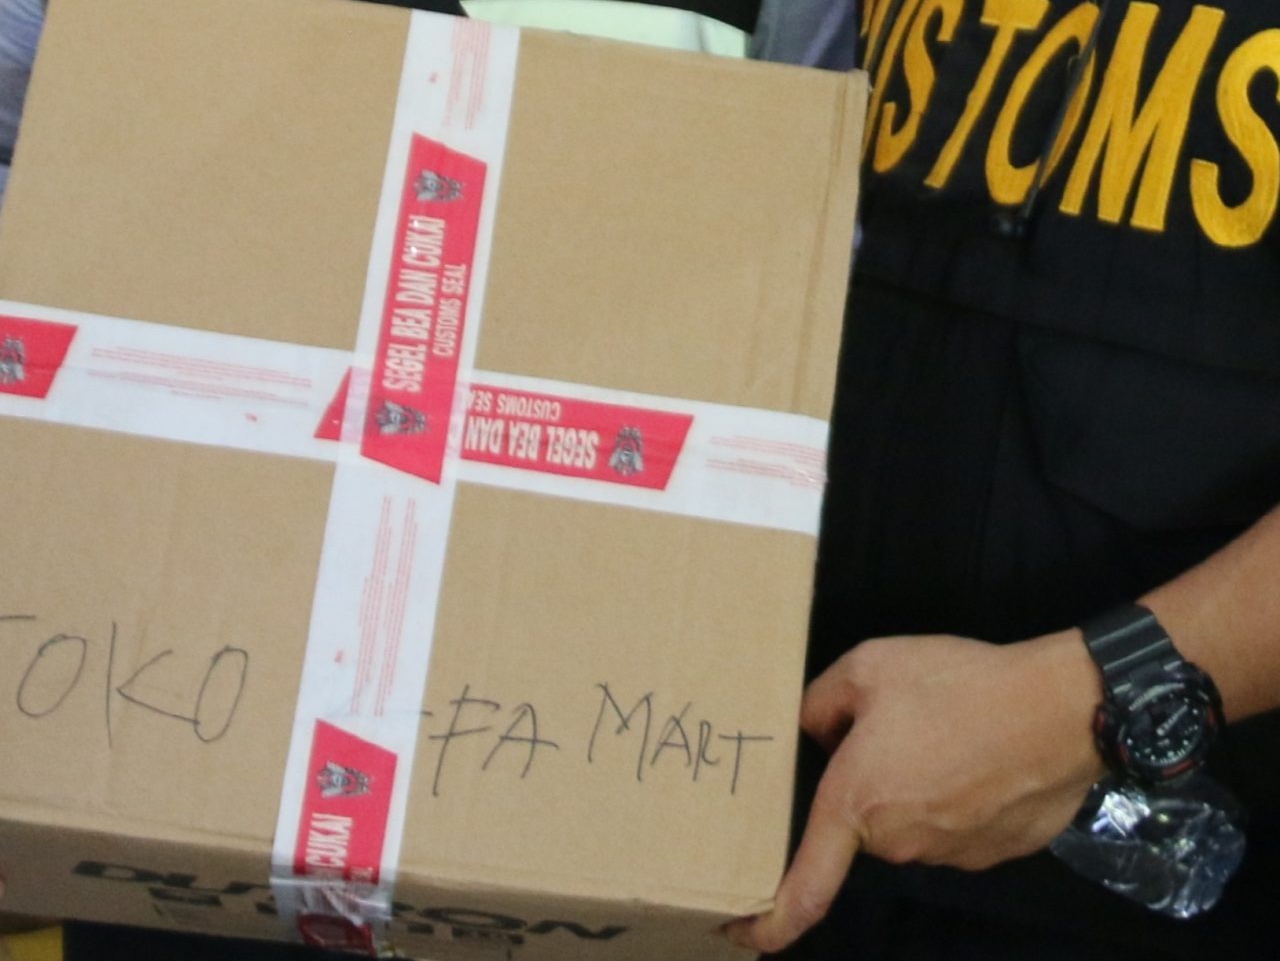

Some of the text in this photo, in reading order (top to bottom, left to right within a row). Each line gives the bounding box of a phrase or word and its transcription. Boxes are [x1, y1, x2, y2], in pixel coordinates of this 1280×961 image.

[382, 214, 446, 394] SEGEL BEA DAN CUKAI
[432, 263, 467, 358] CUSTOMS SEAL
[464, 415, 601, 471] SEGEL BEA DAN
[497, 393, 562, 421] CUSTOMS
[588, 683, 774, 795] MART
[304, 812, 353, 868] CUKAI
